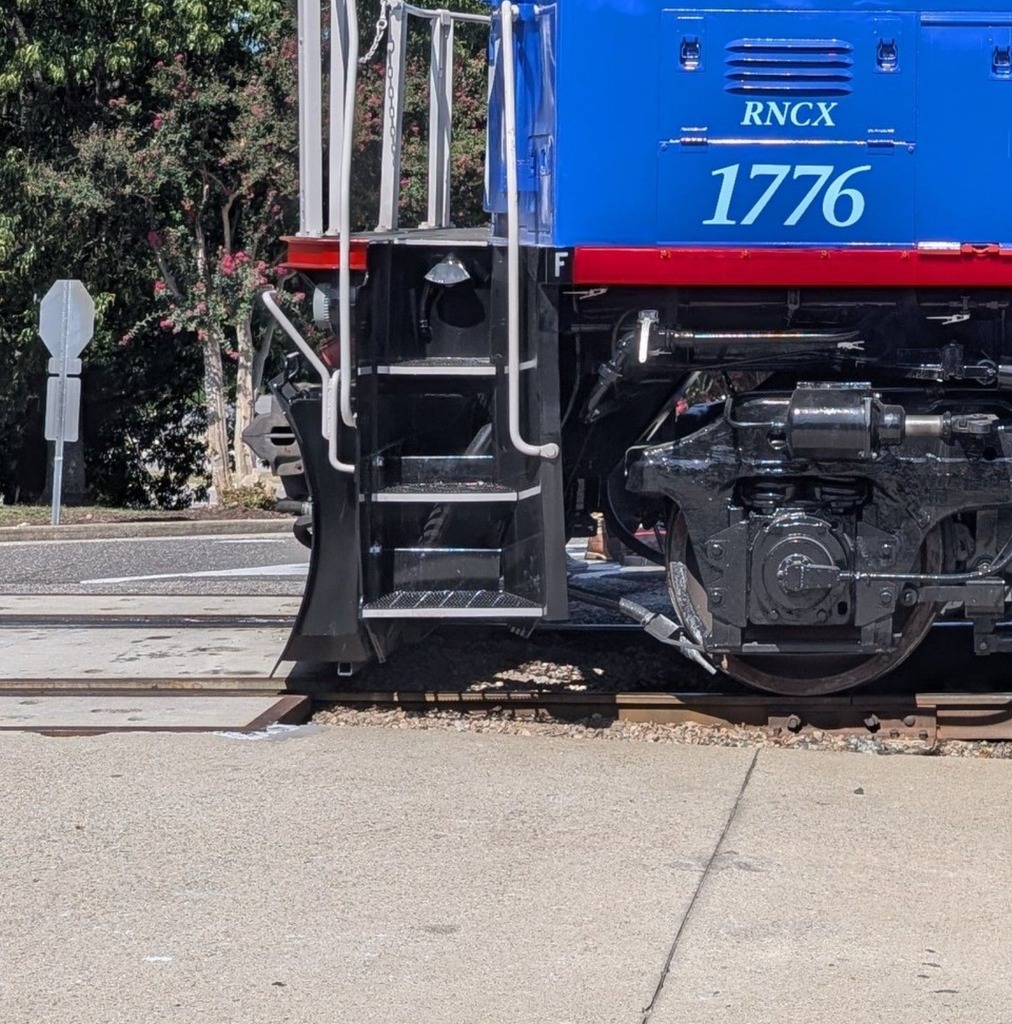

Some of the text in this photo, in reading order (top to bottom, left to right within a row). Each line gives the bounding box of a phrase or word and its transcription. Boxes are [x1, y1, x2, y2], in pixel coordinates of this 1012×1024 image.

[740, 101, 838, 127] RNCX
[702, 163, 871, 227] 1776
[555, 252, 568, 277] F
